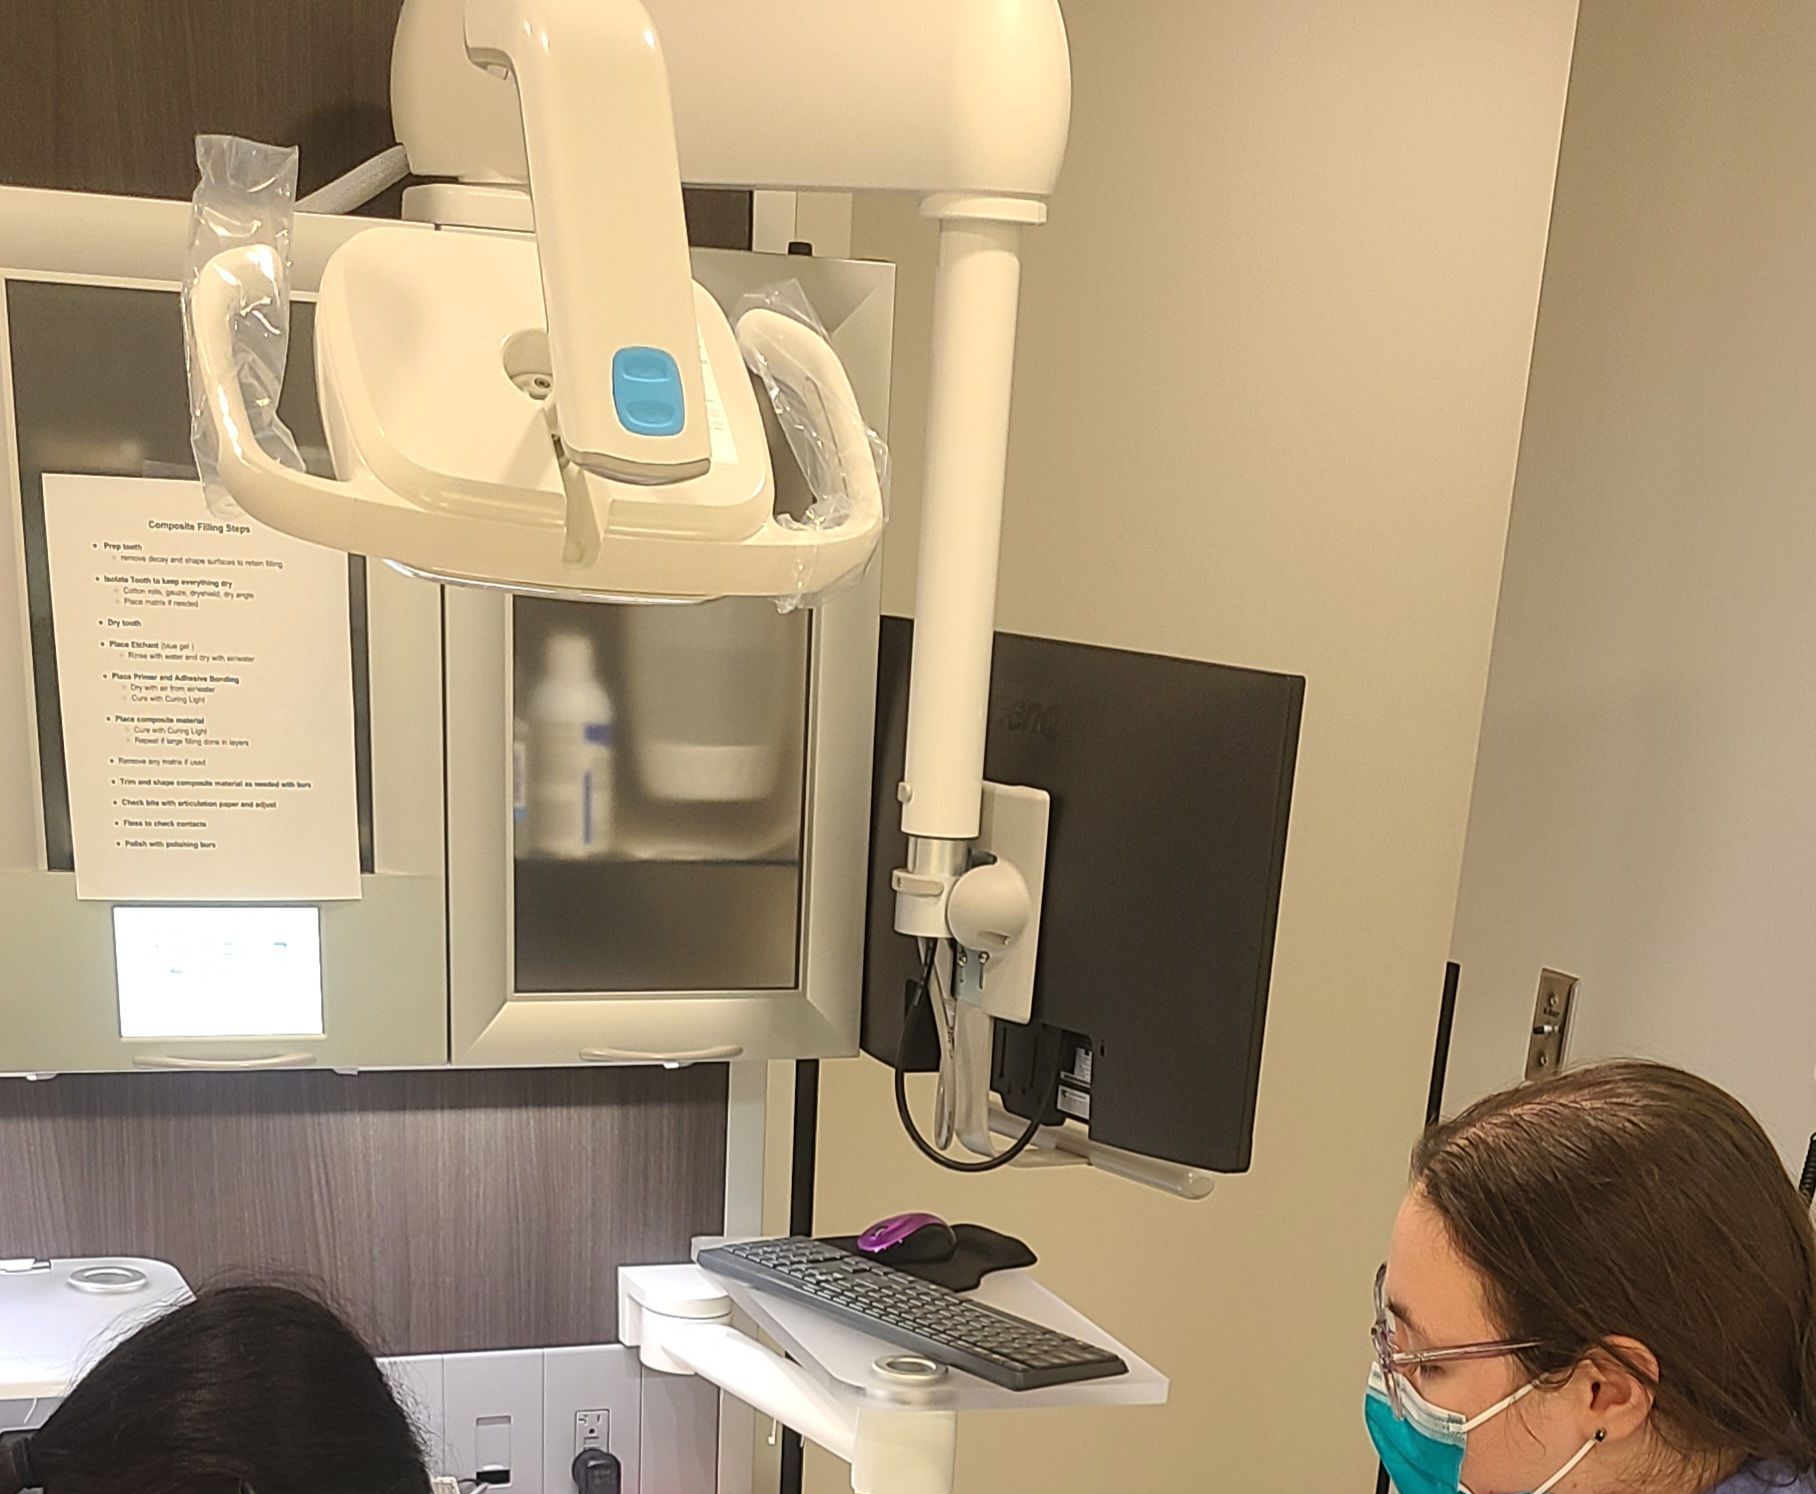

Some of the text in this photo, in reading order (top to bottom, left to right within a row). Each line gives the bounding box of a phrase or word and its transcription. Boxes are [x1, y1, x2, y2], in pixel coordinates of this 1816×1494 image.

[149, 521, 250, 534] Composite Filling Steps
[104, 542, 121, 550] Prep
[104, 575, 128, 583] Isolate
[130, 576, 151, 584] Tooth
[181, 579, 219, 588] everything
[221, 580, 232, 589] dry
[224, 591, 233, 599] dry
[108, 619, 120, 627] Dry
[131, 641, 158, 649] Etchant
[200, 654, 210, 662] dry
[210, 676, 239, 684] Bonding
[131, 684, 142, 692] Dry
[135, 737, 158, 745] Repeat
[167, 738, 183, 746] large
[153, 779, 174, 788] shape
[177, 780, 212, 788] composite
[255, 801, 276, 809] adjust
[125, 840, 147, 848] Polish
[166, 841, 198, 849] polishing
